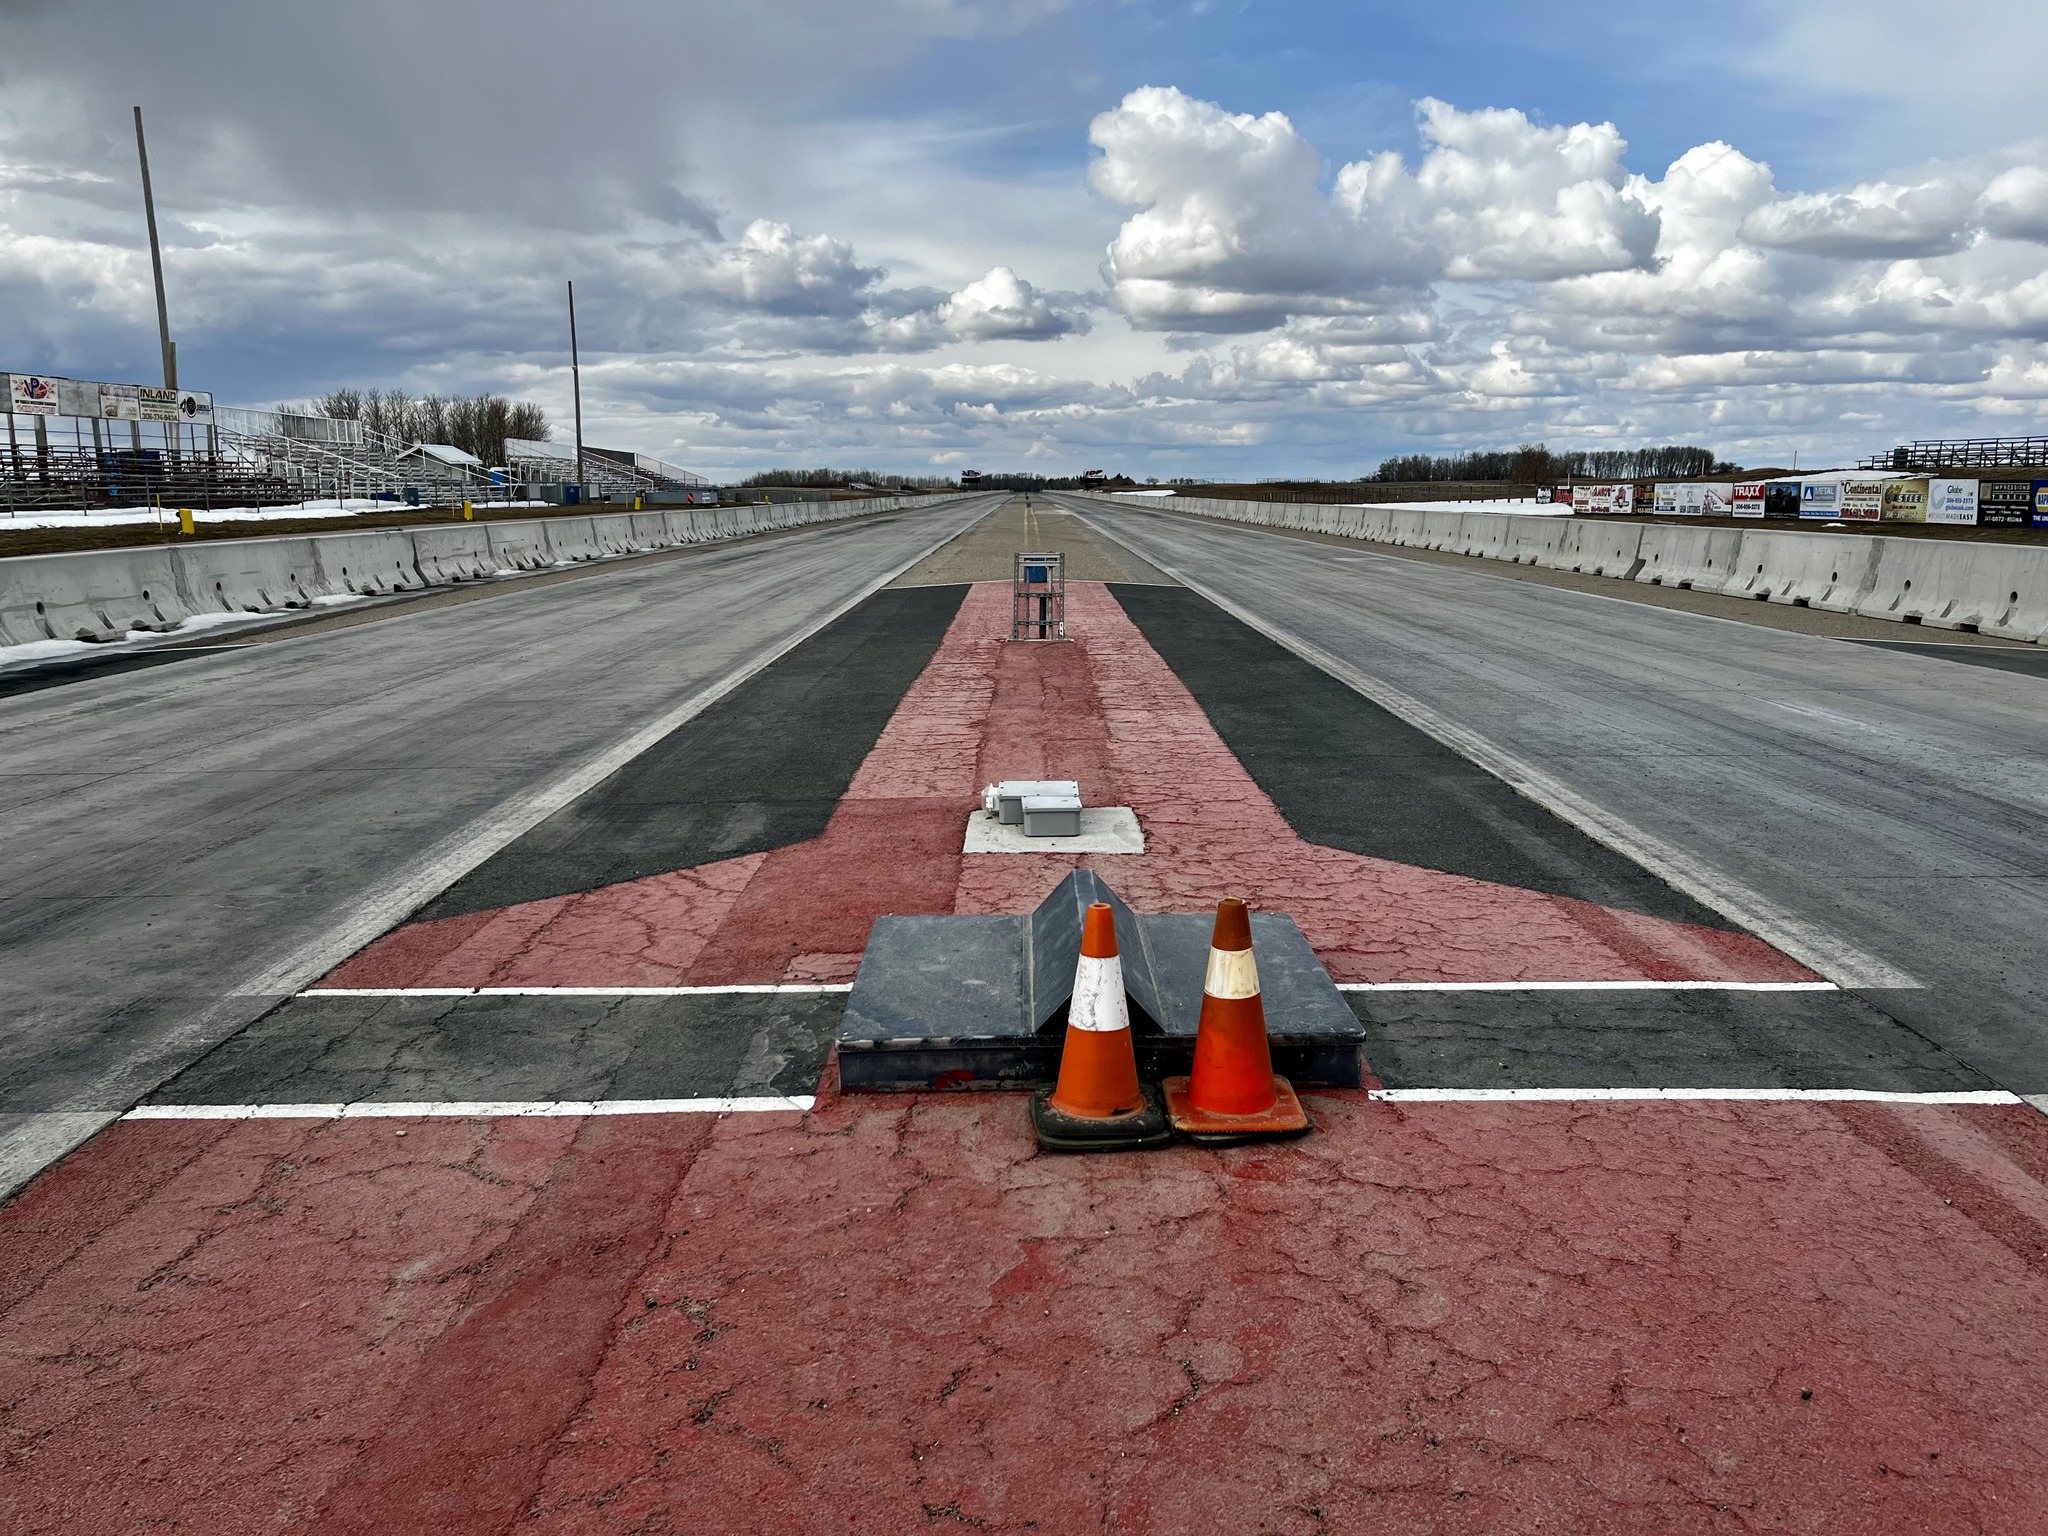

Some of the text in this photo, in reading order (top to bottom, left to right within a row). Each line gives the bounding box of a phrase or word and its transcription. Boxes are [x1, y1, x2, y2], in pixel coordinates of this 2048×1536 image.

[140, 388, 176, 400] INLAND
[1735, 486, 1760, 497] TRAXX
[1815, 487, 1835, 495] METAL
[1844, 482, 1882, 494] Continental
[1947, 485, 1963, 493] Globe
